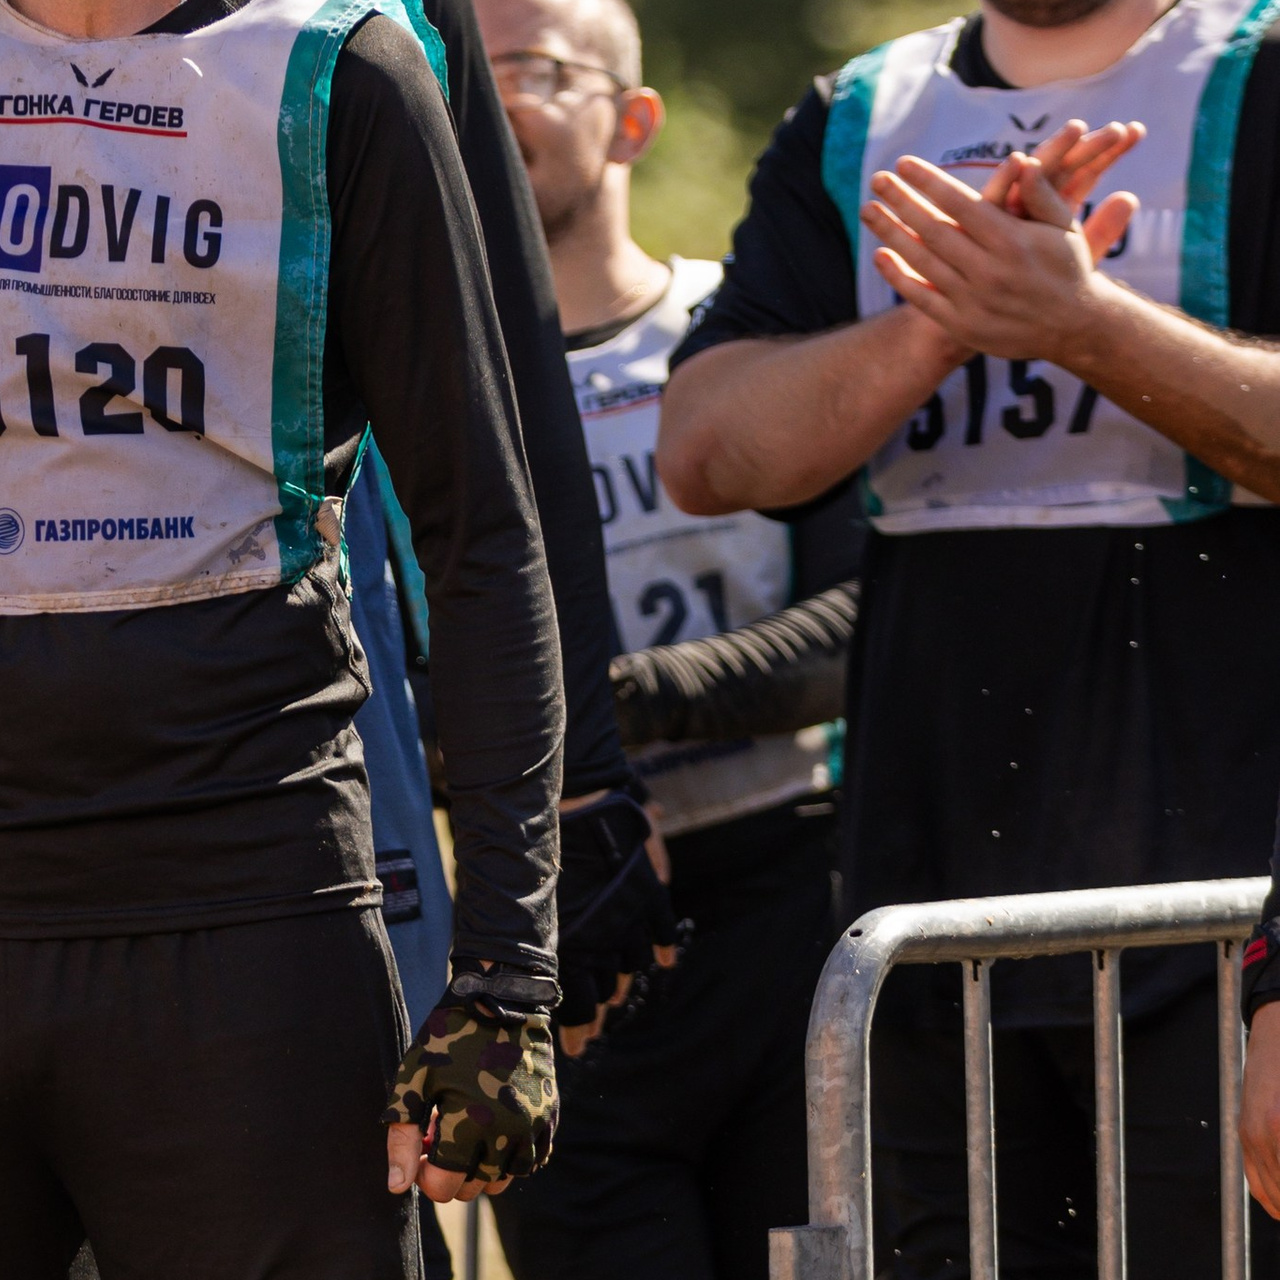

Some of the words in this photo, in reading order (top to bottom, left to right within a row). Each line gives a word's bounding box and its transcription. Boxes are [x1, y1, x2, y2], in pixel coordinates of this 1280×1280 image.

[83, 98, 184, 128] ГЕРОЕВ
[93, 286, 171, 303] БЛАГОСОСТОЯНИЕ
[172, 291, 192, 305] ДЛЯ
[192, 292, 217, 305] ВСЕХ
[34, 516, 196, 542] ГАЗПРОМБАНК
